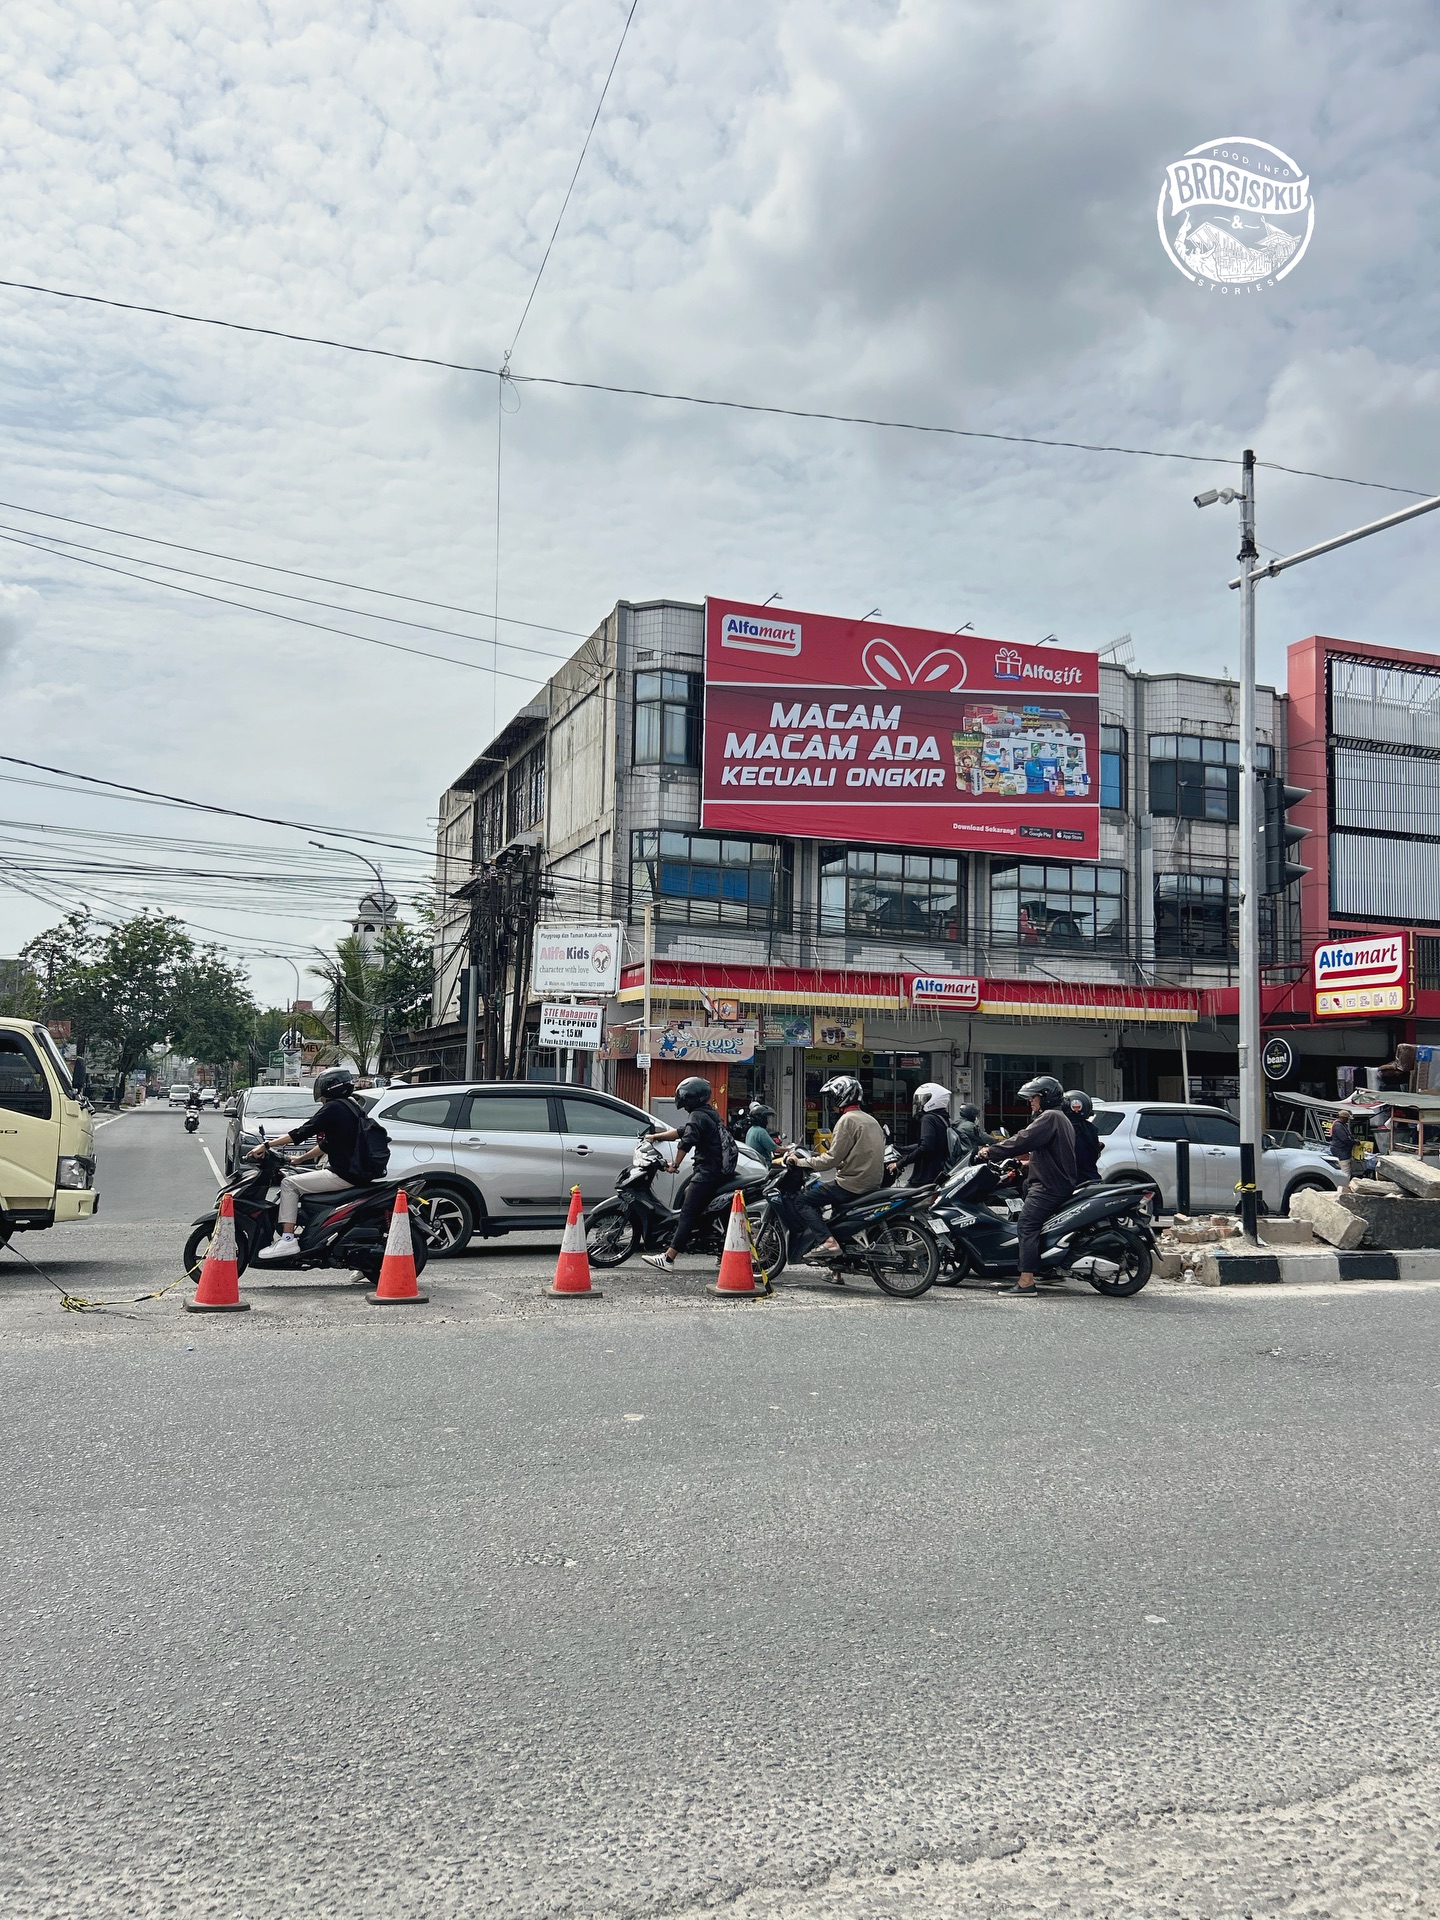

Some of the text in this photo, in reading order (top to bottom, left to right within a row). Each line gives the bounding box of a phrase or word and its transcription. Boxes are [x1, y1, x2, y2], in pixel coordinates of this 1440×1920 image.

[727, 619, 796, 641] Alfamart
[1022, 663, 1083, 685] Alfagift
[769, 702, 901, 731] MACAM
[724, 732, 941, 761] MACAM ADA
[720, 766, 946, 788] KECUALI ONGKIR
[953, 823, 1017, 835] Download Sekarang!
[567, 946, 590, 960] Kids
[1319, 943, 1398, 969] Alfamart
[539, 965, 589, 974] character with love
[915, 978, 977, 995] Alfamart
[544, 1008, 598, 1020] STIE Mahaputra
[544, 1018, 597, 1028] IPI-LEPPINDO
[574, 1029, 583, 1038] KM
[827, 1051, 841, 1063] go!
[1266, 1053, 1287, 1065] bean!
